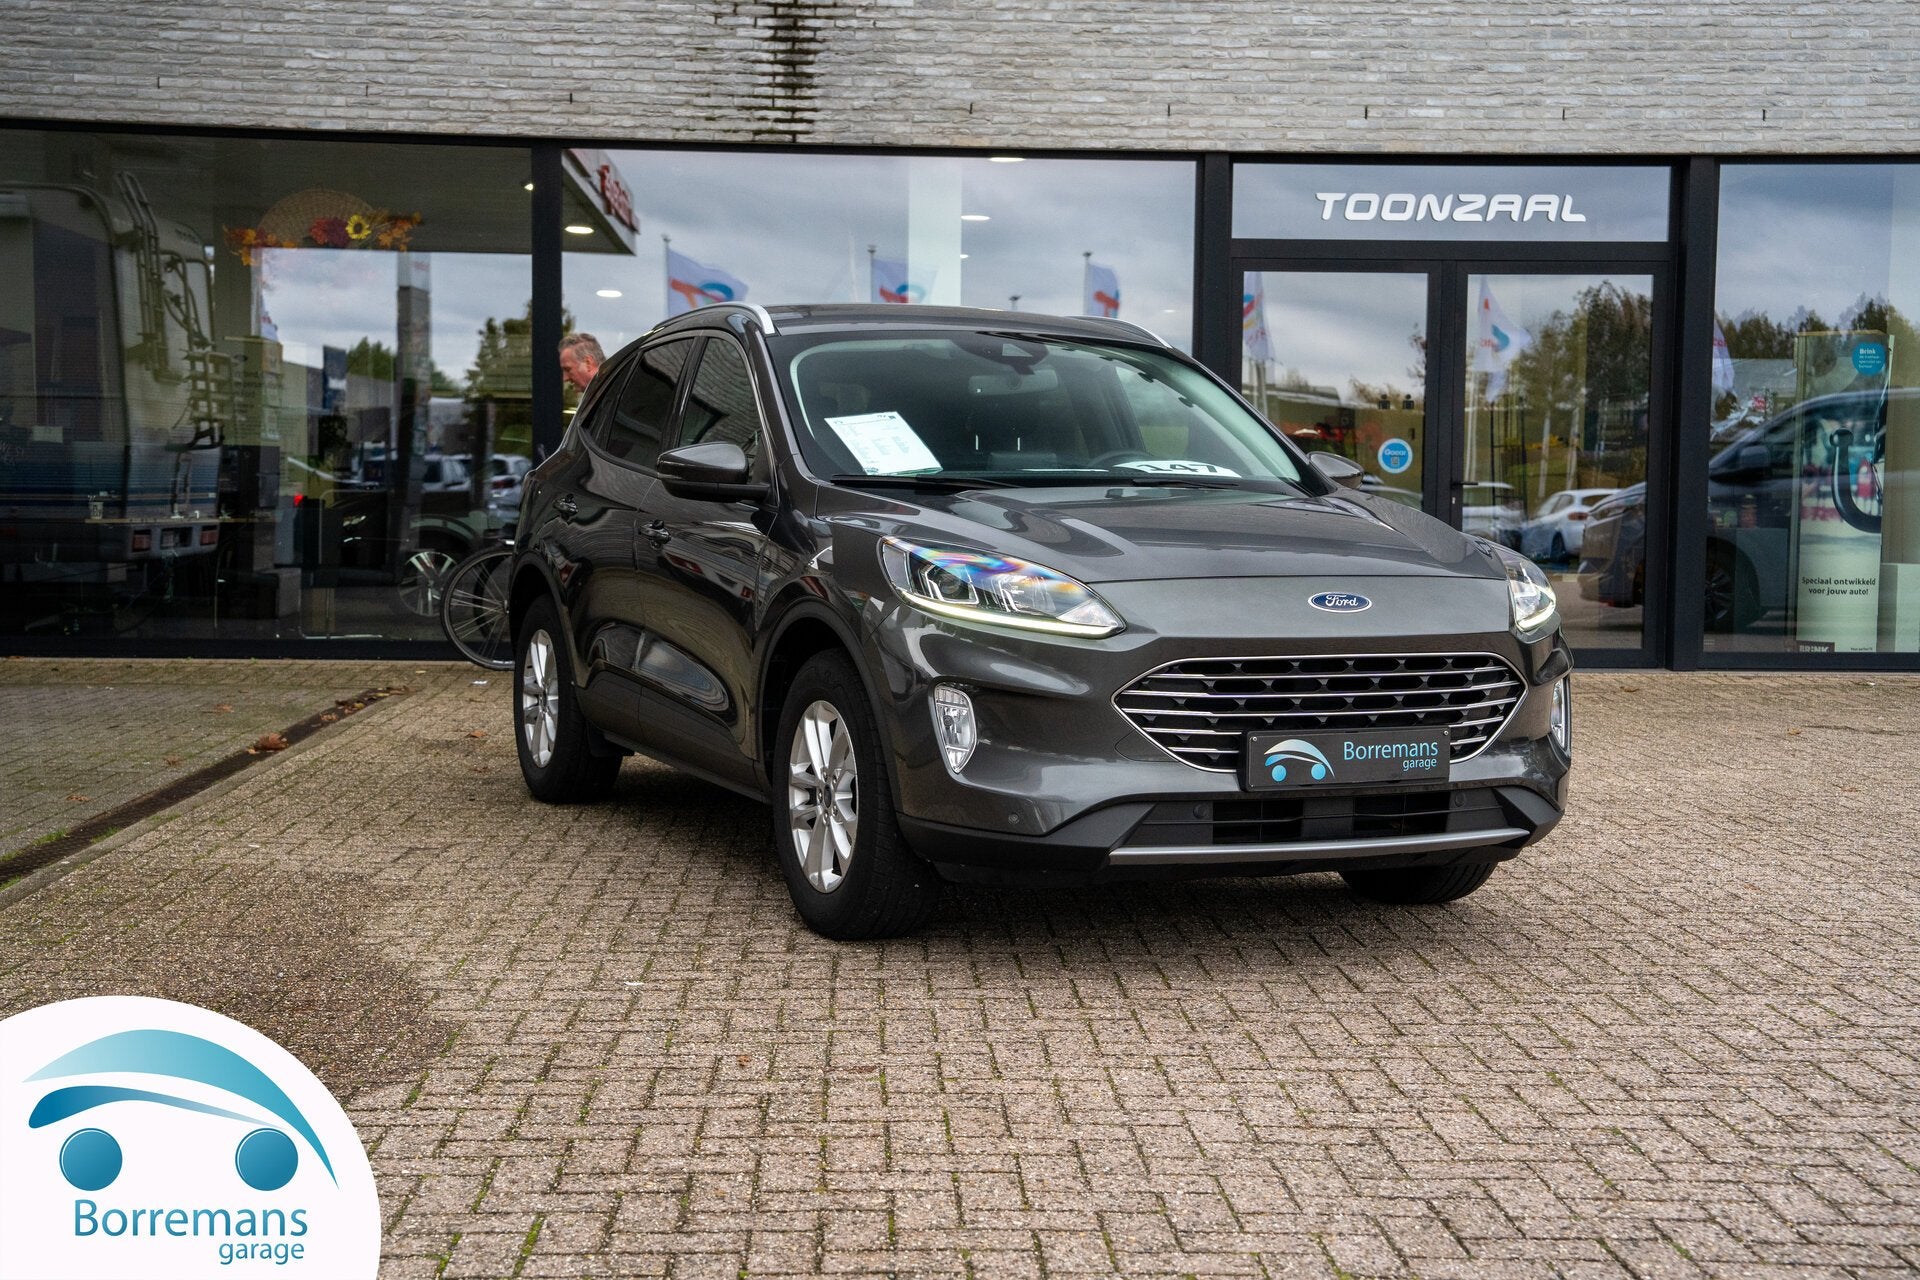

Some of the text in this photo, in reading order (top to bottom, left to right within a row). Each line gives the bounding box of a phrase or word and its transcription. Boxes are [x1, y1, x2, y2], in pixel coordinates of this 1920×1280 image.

[1315, 192, 1587, 223] TOONZAAL
[1801, 576, 1876, 586] Speciaal ontwikkeld
[1808, 586, 1869, 597] voor jouw auto!
[1324, 594, 1360, 608] Ford
[1342, 740, 1440, 761] Borremans
[1401, 758, 1437, 771] garage
